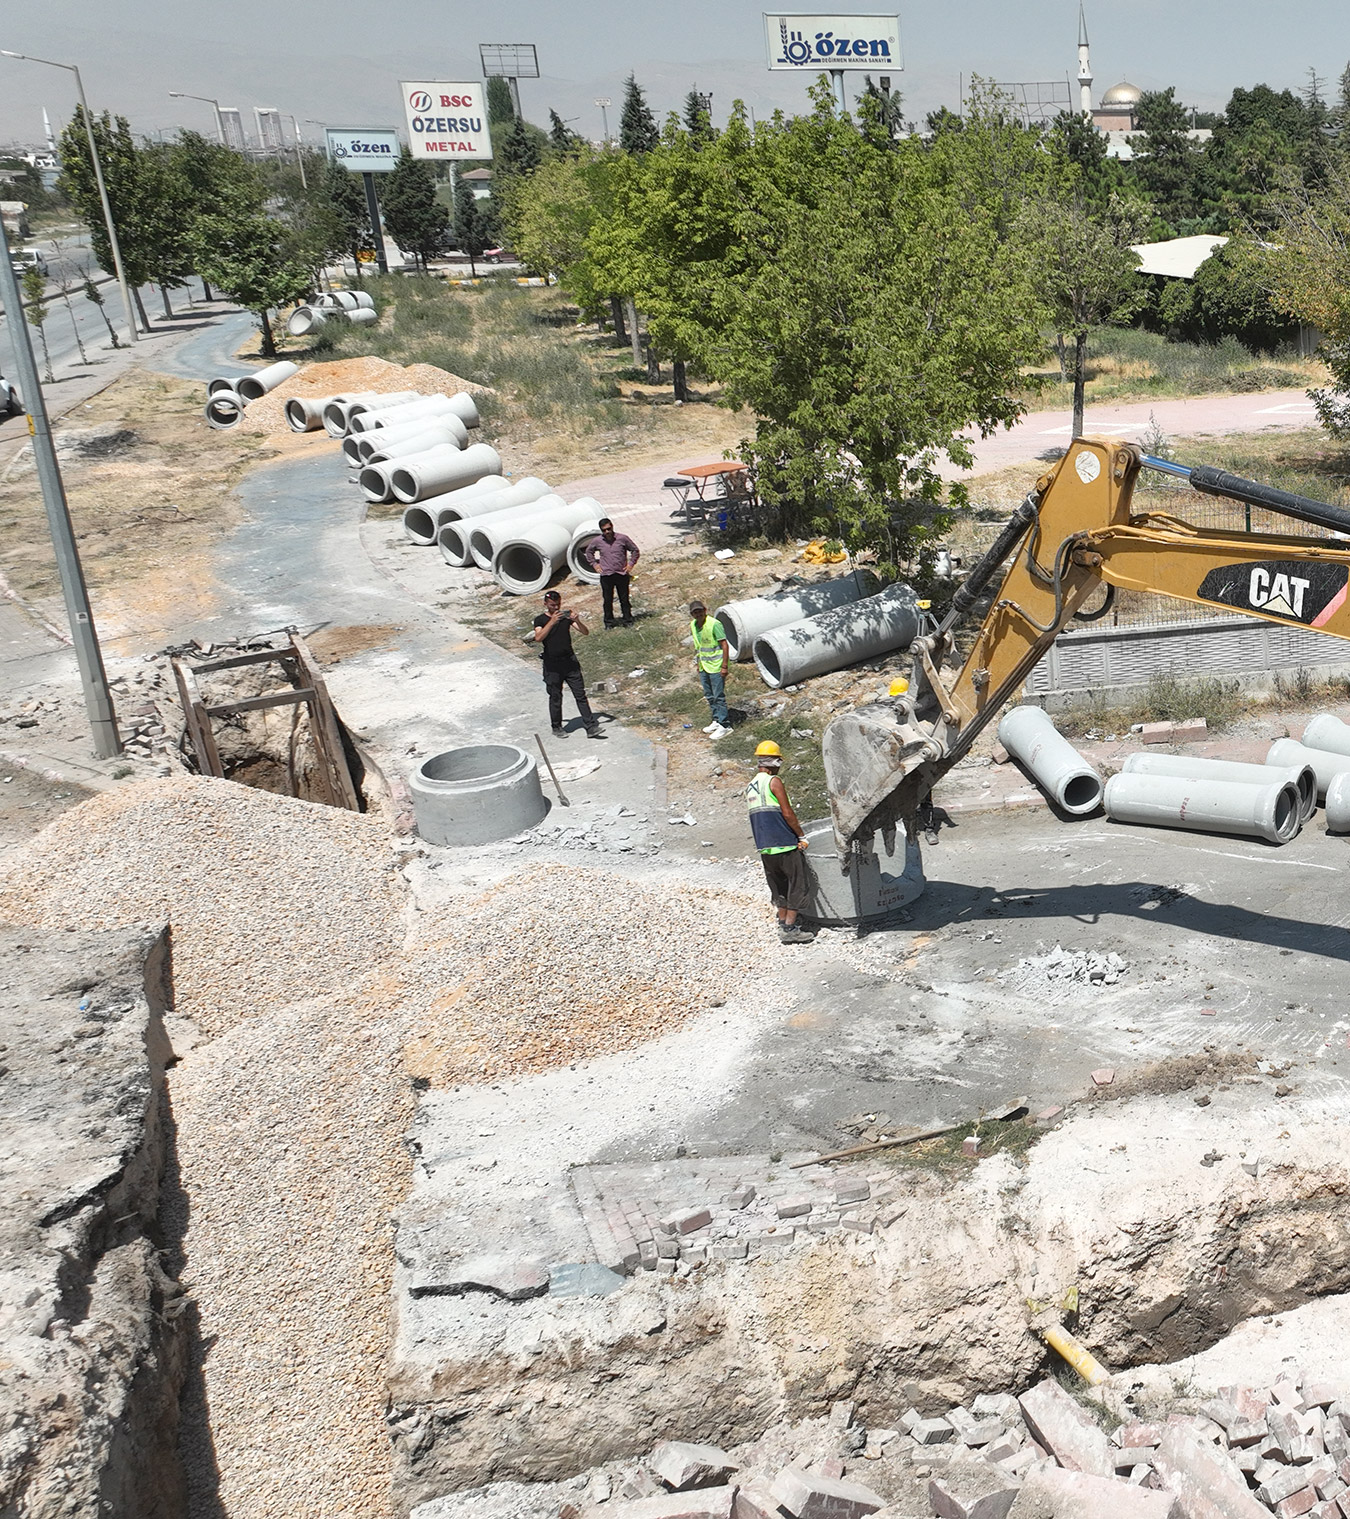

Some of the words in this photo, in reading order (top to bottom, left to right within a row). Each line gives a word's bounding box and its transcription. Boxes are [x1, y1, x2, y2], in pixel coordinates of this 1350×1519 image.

[815, 32, 891, 56] özen
[440, 95, 472, 108] BSC
[412, 115, 482, 133] ÖZERSU
[350, 140, 391, 153] özen
[425, 141, 477, 152] METAL
[1249, 567, 1310, 618] CAT
